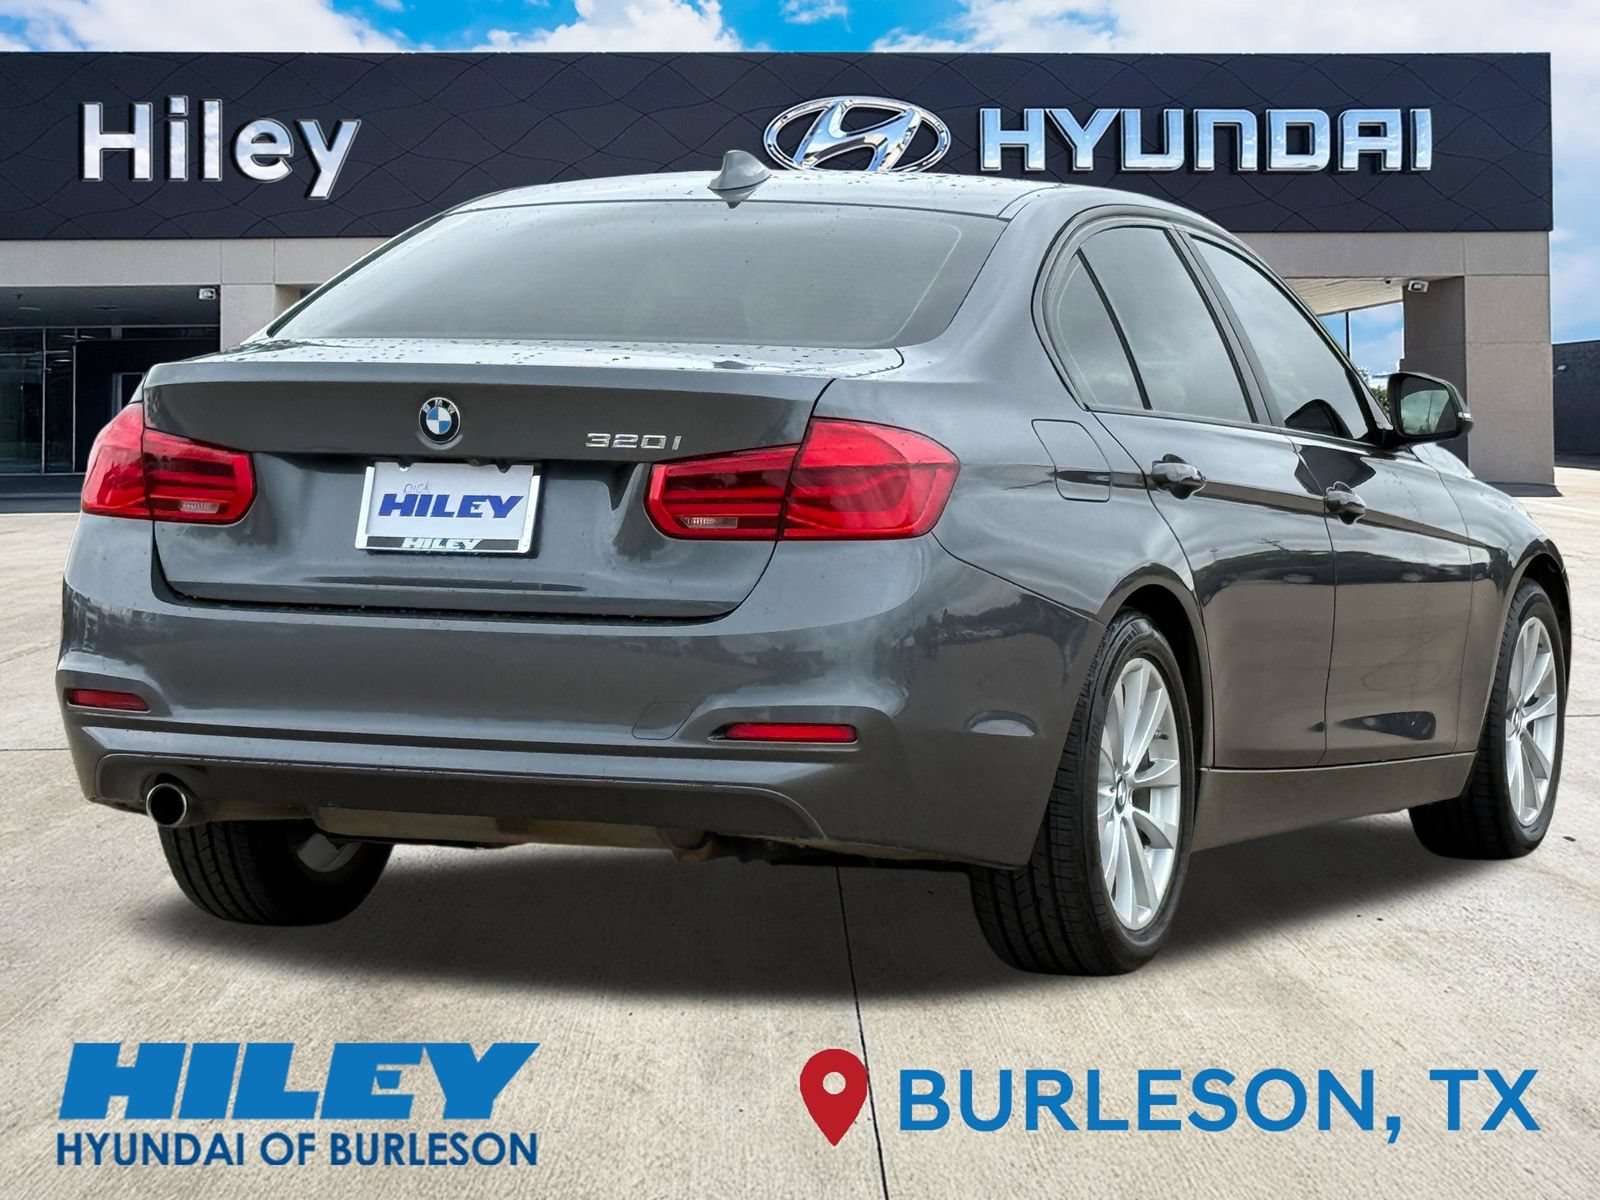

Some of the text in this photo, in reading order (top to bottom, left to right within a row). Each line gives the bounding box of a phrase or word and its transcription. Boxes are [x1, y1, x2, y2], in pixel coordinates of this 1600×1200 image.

[81, 95, 362, 199] Hiley
[979, 106, 1433, 172] HYUNDAI
[378, 493, 524, 519] HILEY
